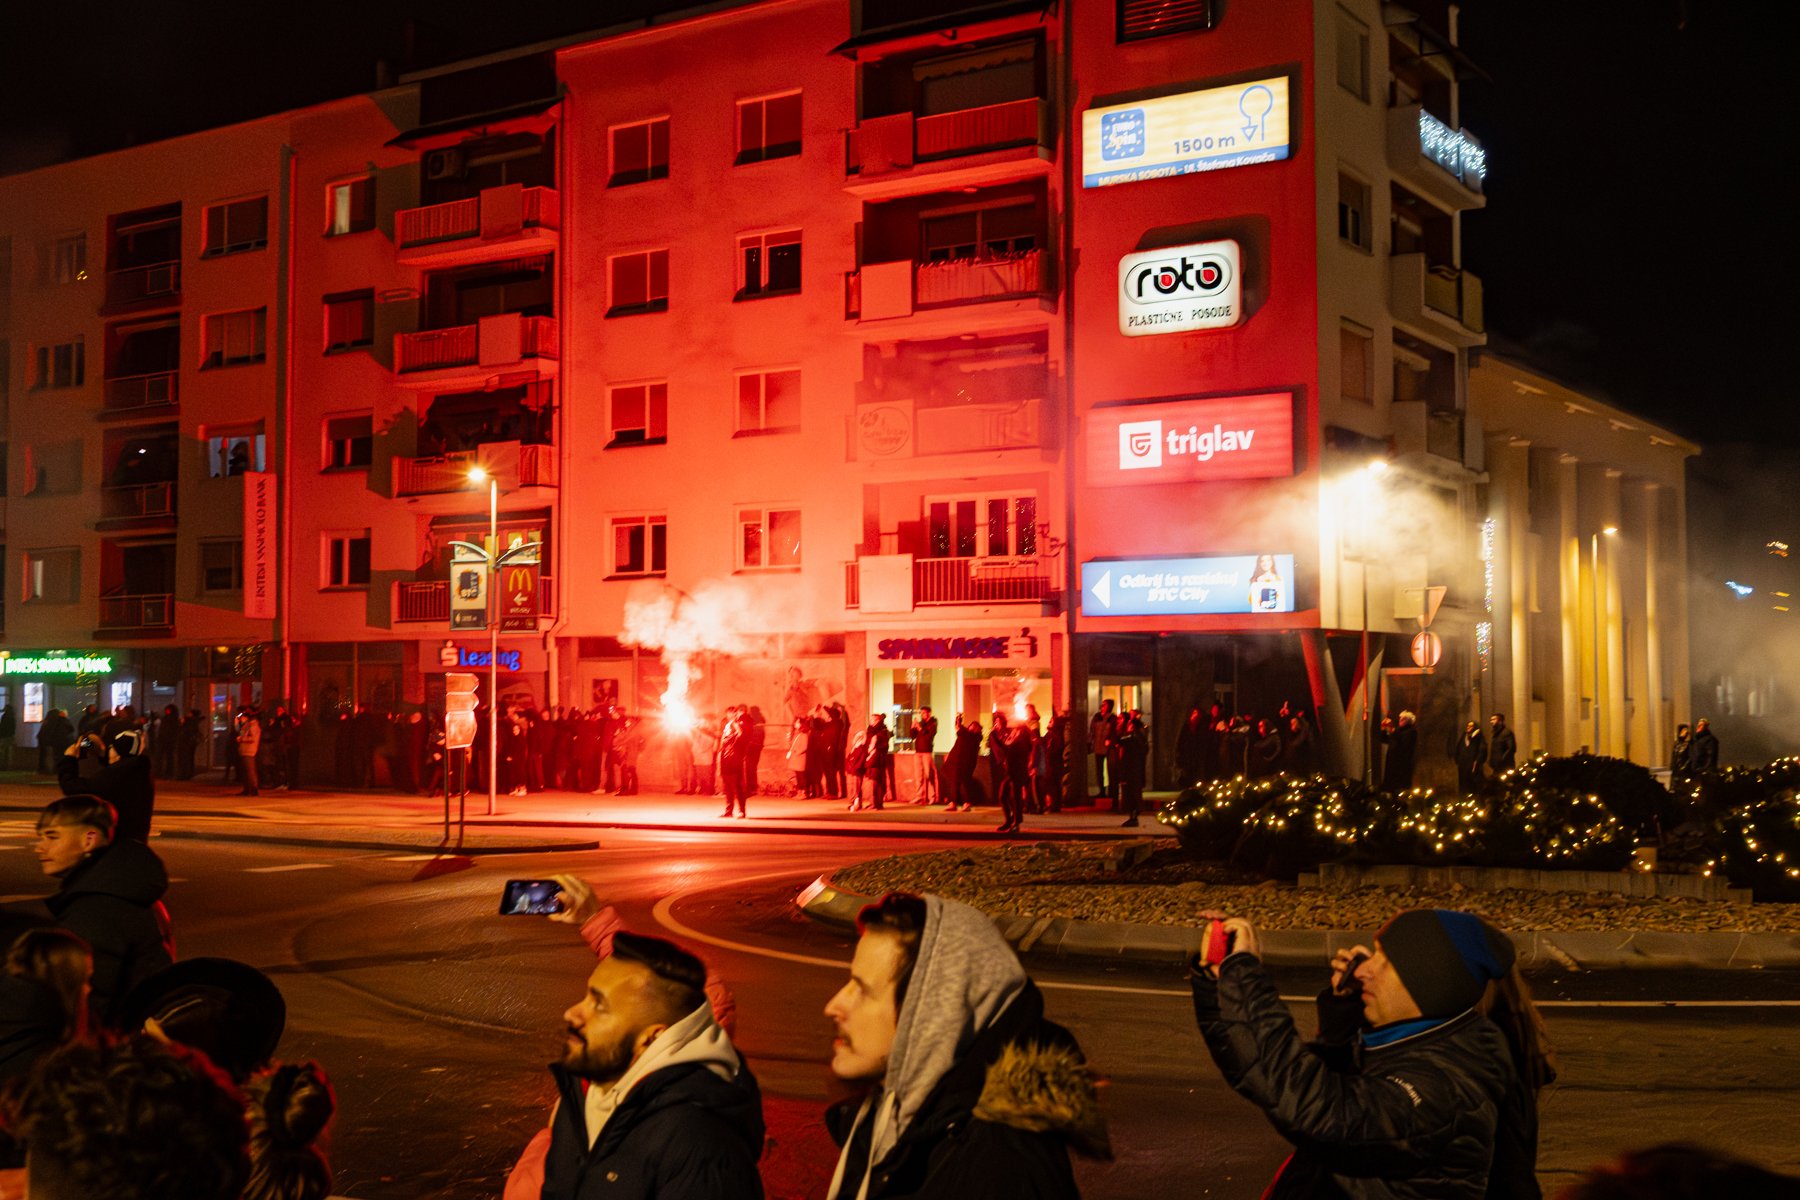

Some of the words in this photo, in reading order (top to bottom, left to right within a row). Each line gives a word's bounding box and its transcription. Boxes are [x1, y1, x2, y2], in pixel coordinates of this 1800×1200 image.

[1174, 136, 1213, 155] 1500
[1218, 135, 1236, 147] m
[1138, 165, 1177, 181] SOBOTA
[1137, 257, 1223, 297] roto
[1191, 305, 1232, 320] POSODE
[1166, 424, 1255, 461] triglav
[1179, 588, 1210, 603] City
[878, 636, 1011, 660] SPARKASSE
